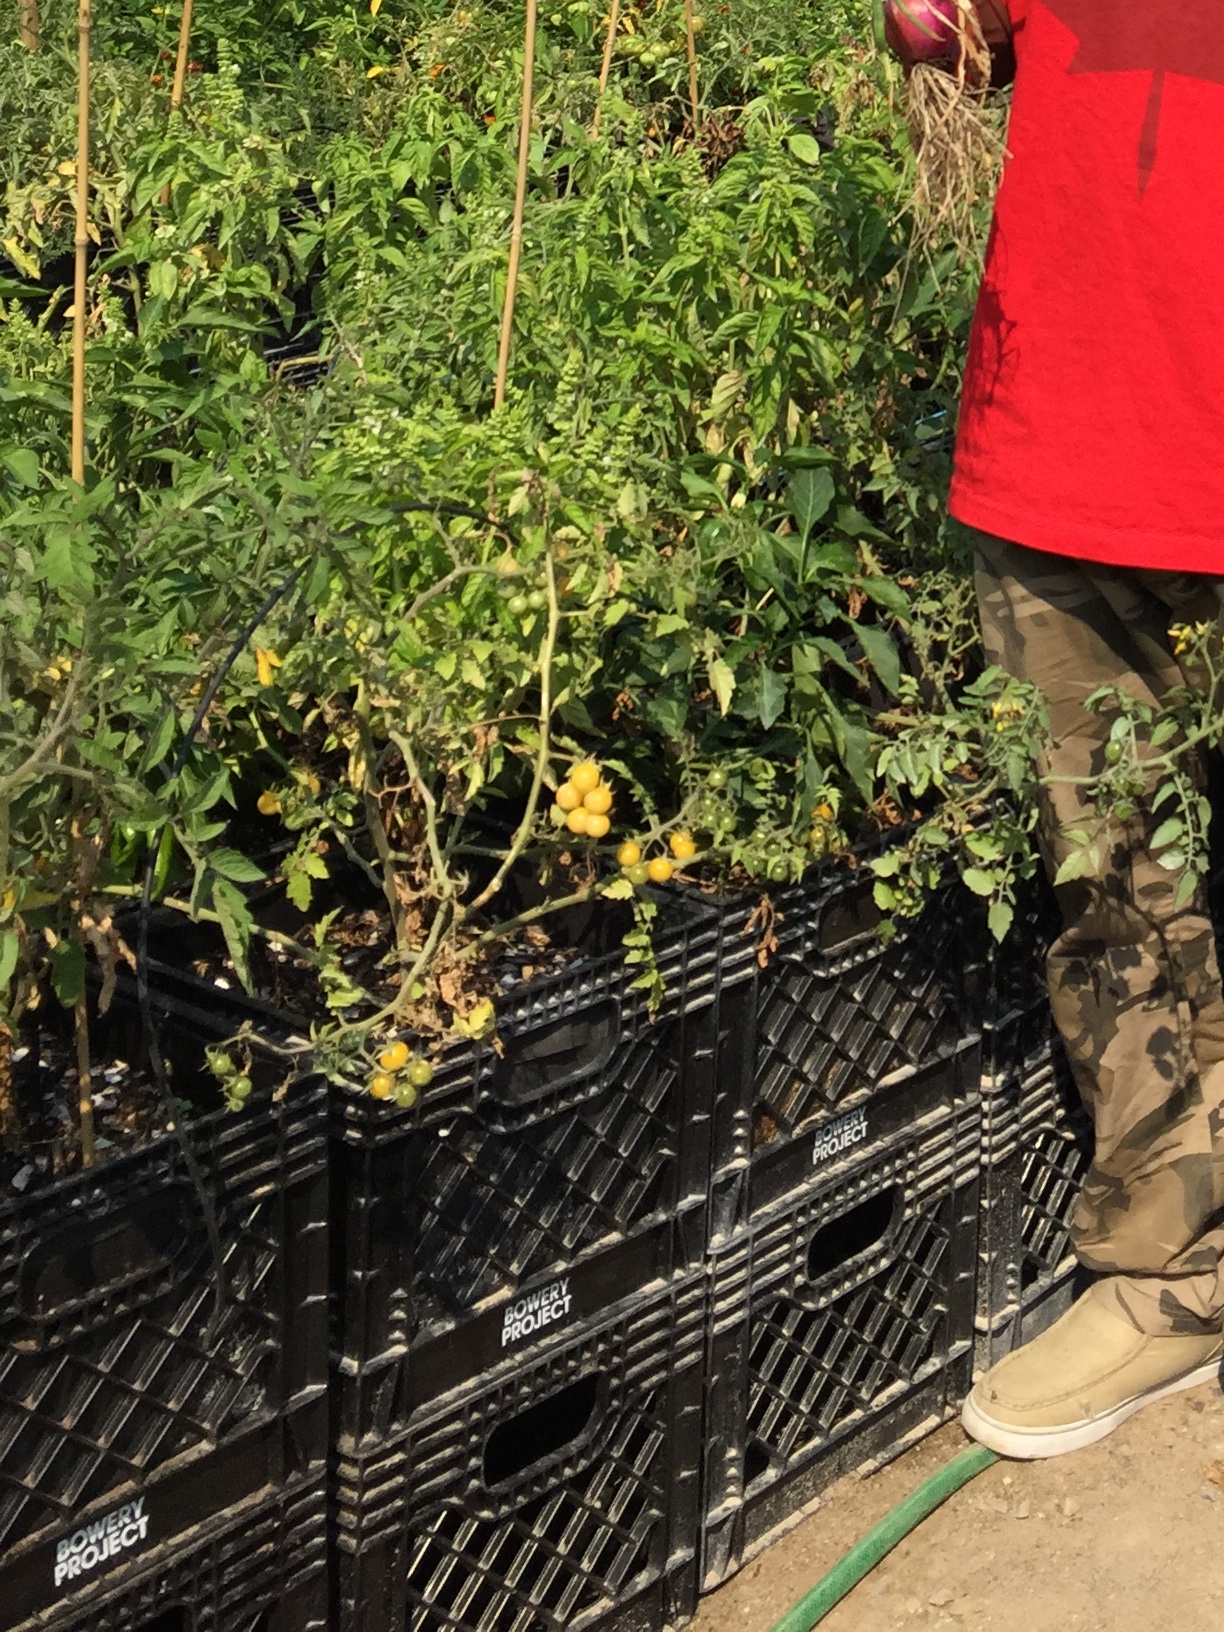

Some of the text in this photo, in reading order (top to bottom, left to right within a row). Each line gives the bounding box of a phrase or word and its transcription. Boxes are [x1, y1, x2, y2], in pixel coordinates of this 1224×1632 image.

[812, 1121, 869, 1166] PROJECT
[814, 1105, 868, 1147] BOWERY
[501, 1294, 573, 1347] PROJECT
[504, 1276, 570, 1326] BOWERY
[54, 1514, 150, 1587] PROJECT
[56, 1495, 146, 1563] BOWERY
